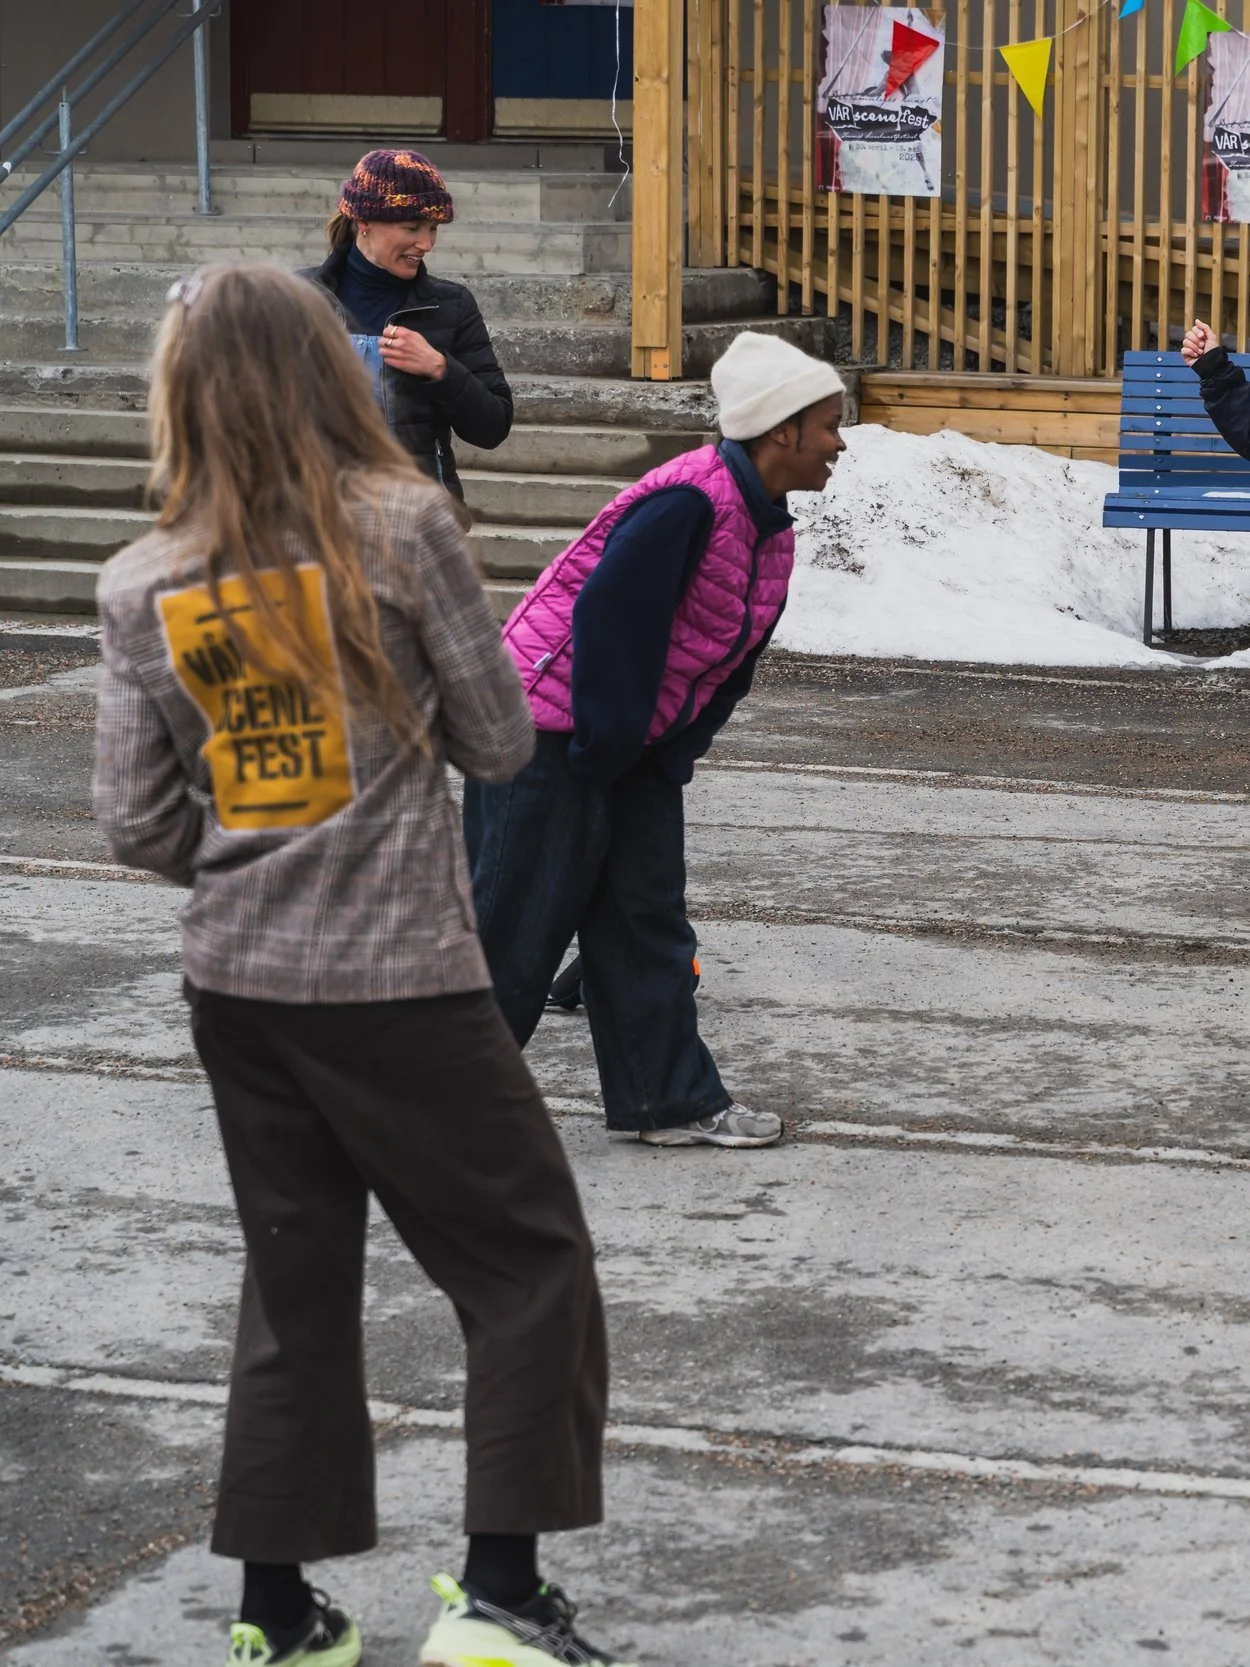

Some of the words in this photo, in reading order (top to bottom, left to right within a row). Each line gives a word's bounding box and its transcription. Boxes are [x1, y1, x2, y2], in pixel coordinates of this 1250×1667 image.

[901, 109, 929, 129] fest
[217, 680, 326, 733] CEN
[230, 730, 326, 784] FEST
